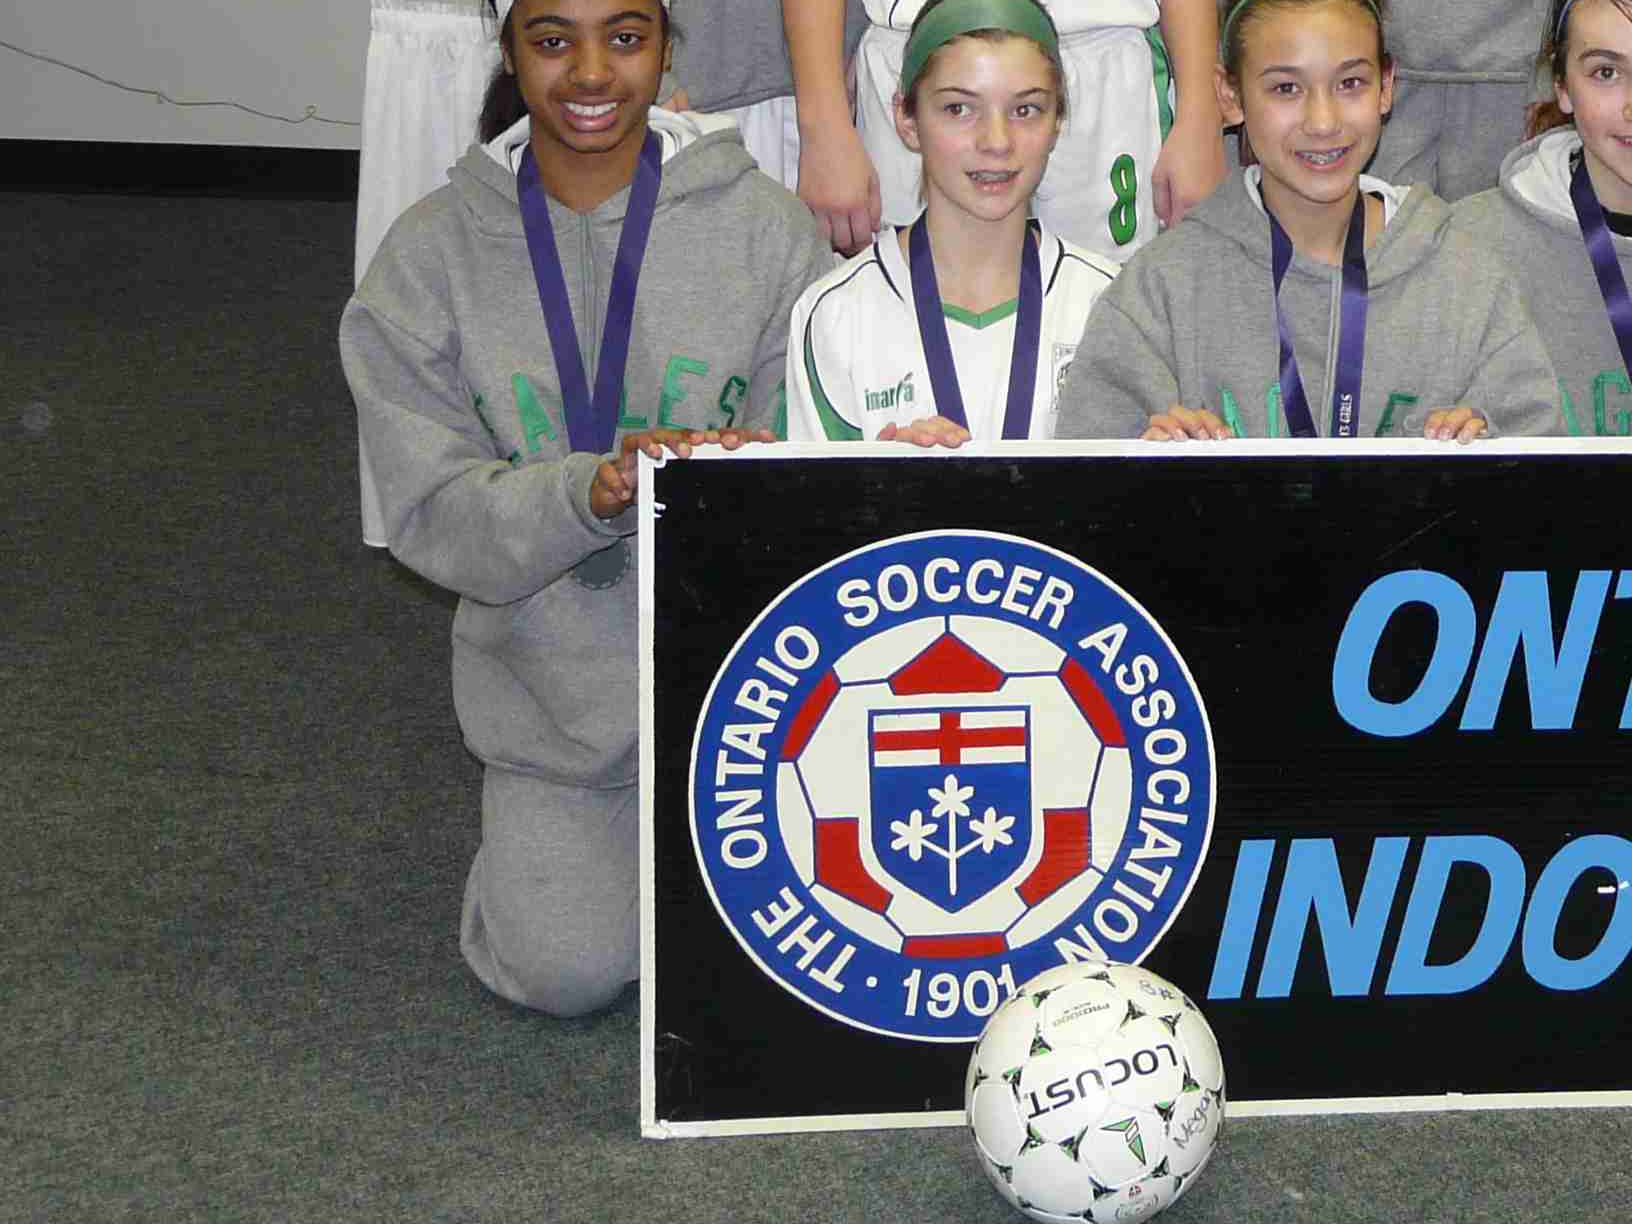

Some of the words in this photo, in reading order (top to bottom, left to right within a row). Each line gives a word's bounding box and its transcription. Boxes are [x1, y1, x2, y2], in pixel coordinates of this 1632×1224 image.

[1107, 153, 1137, 246] 8
[836, 557, 1075, 630] SOCCER
[716, 624, 820, 871] ONTARIO
[1054, 621, 1190, 966] ASSOCIATION
[752, 885, 856, 994] THE
[902, 962, 1018, 1018] 1901
[1027, 1043, 1179, 1120] LOCUST
